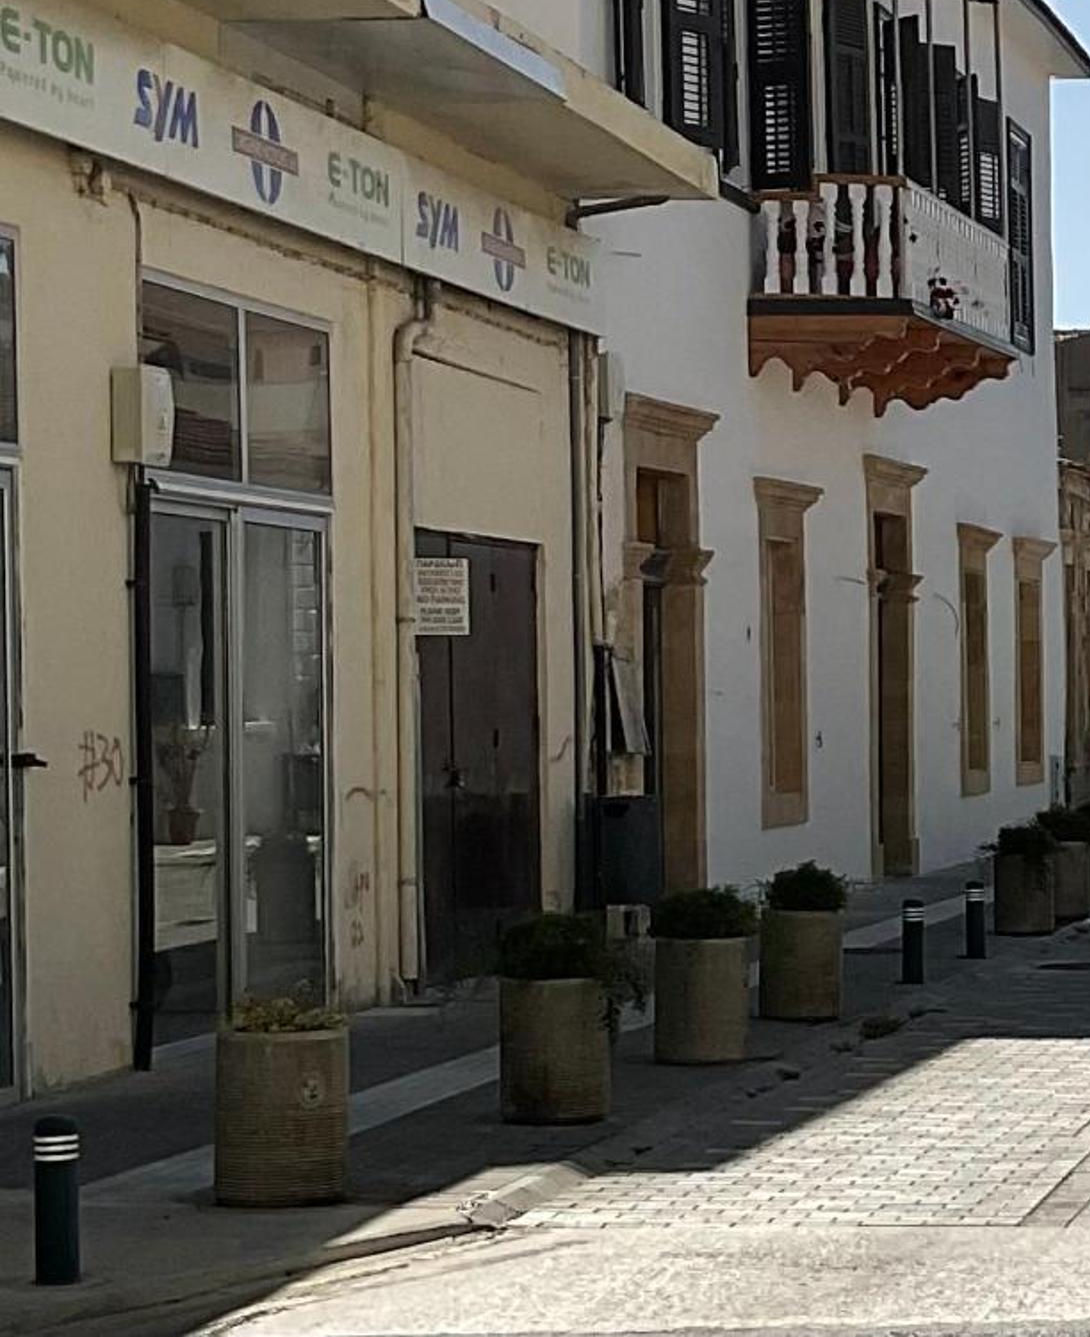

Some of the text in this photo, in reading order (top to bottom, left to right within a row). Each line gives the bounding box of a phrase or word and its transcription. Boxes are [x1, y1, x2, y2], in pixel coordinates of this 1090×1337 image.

[0, 6, 95, 85] E-TON
[133, 68, 199, 149] SYM
[327, 151, 390, 208] E-TON
[416, 190, 459, 253] SYM
[546, 245, 591, 289] E-TON
